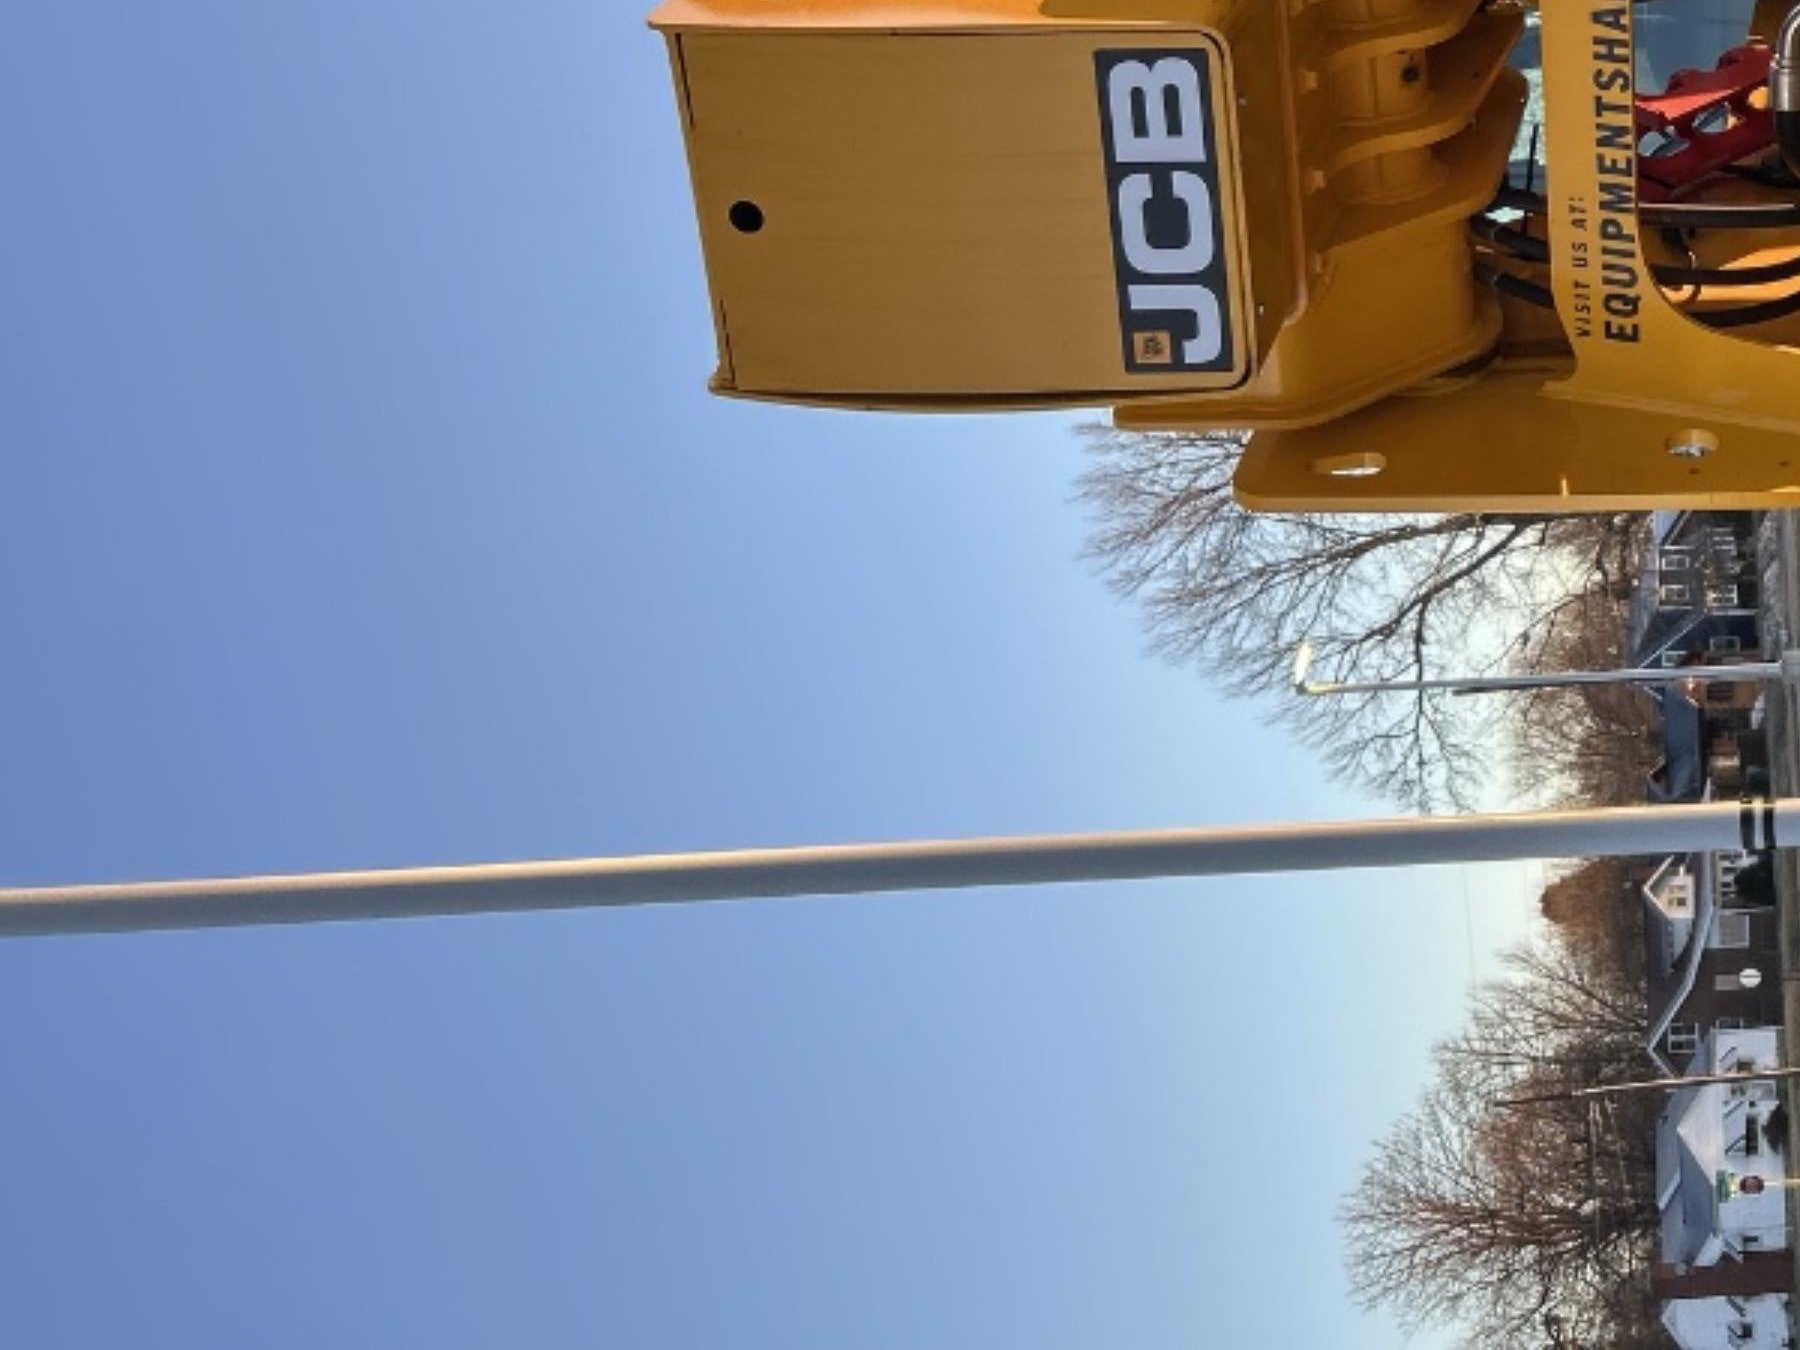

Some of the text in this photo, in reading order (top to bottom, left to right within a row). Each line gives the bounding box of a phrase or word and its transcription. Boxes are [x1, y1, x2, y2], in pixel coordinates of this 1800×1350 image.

[1108, 56, 1223, 364] JCB
[1568, 196, 1592, 338] VISIT US AT:
